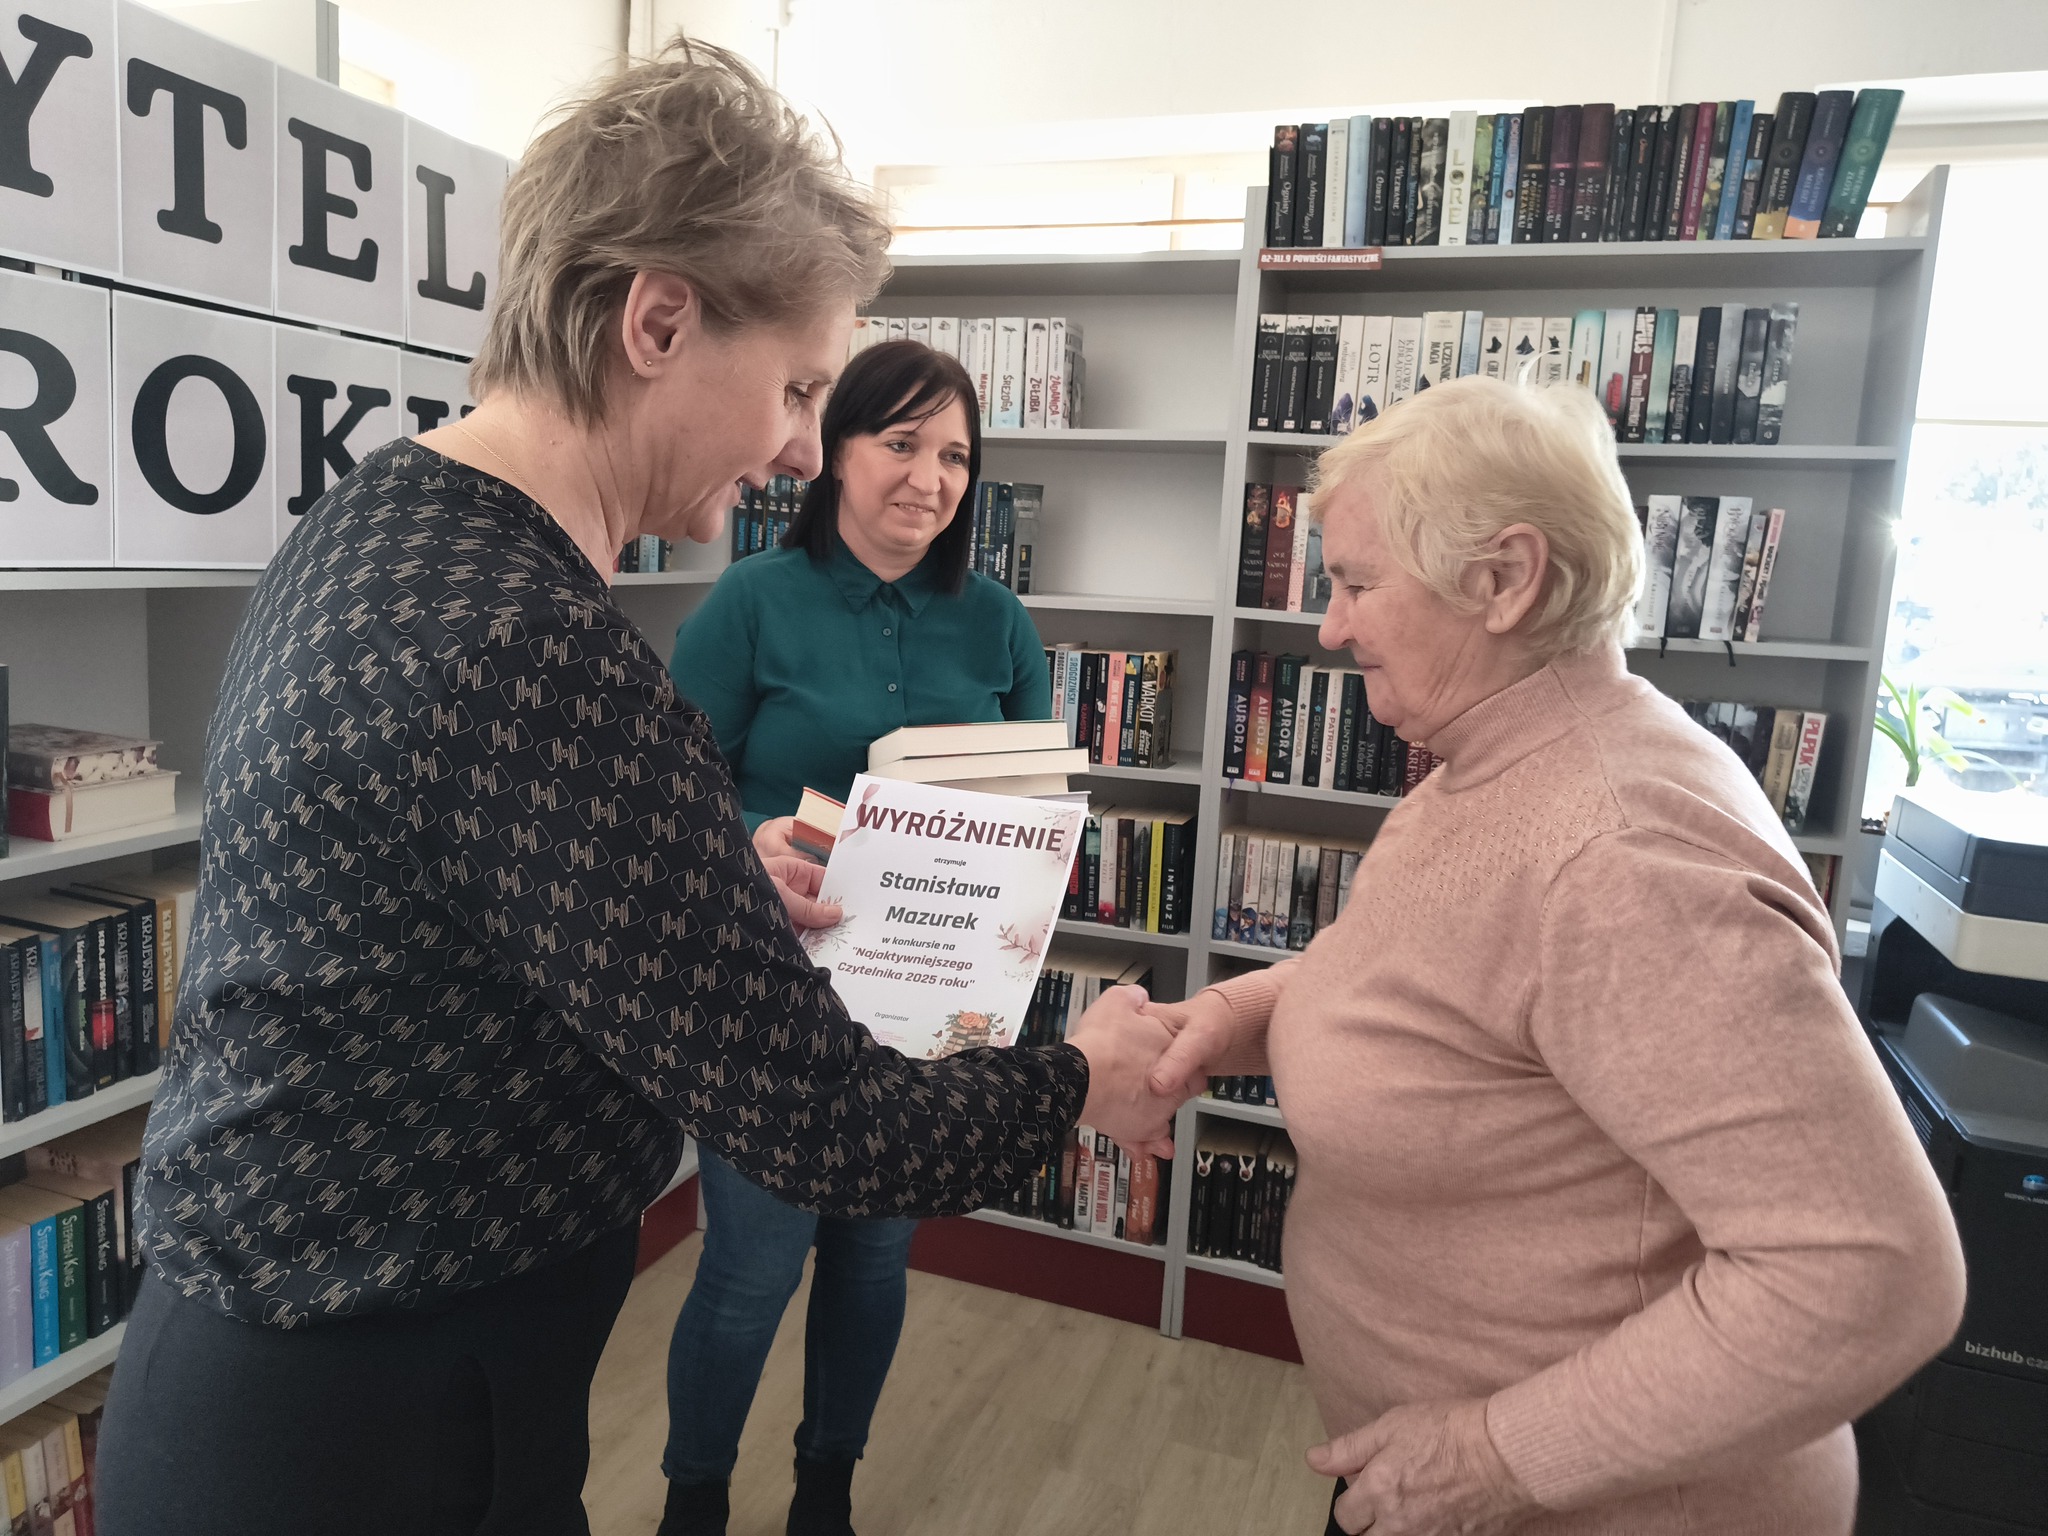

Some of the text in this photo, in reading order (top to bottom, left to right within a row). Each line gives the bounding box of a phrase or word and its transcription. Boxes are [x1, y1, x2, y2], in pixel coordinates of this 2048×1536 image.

[1429, 341, 1441, 365] MAGA
[1633, 313, 1656, 354] IMPULS
[1366, 343, 1382, 385] ŁOTR
[1401, 339, 1416, 392] KRÓLOWA
[1029, 377, 1042, 413] ZGŁOBA
[0, 327, 476, 516] ROK
[1000, 543, 1008, 570] Kocham
[1056, 656, 1066, 690] ROGOZIŃSKI
[1067, 662, 1080, 705] ROGOZIŃSKI
[1139, 680, 1158, 725] WARKOT
[1232, 694, 1247, 754] AURORA
[1255, 696, 1270, 756] AURORA
[1278, 698, 1294, 759] AURORA
[1310, 714, 1321, 756] GENIUSZ
[1325, 716, 1336, 764] PATRIOTA
[1339, 717, 1352, 775] BUNTOWNIK
[1355, 740, 1367, 781] KRÓLÓW
[1364, 743, 1377, 778] STARCIE
[1406, 748, 1420, 786] KREW
[859, 804, 1065, 852] WYRÓŻNIENIE
[934, 856, 967, 868] otrzymuje
[879, 870, 1001, 900] Stanisława
[1164, 868, 1176, 921] INTRUZ
[884, 905, 979, 930] Mazurek
[115, 922, 130, 996] KRAJEWSKI
[141, 914, 153, 993] KRAJEWSKI
[161, 909, 174, 993] KRAJEWSKI
[852, 946, 973, 972] "Najaktywniejszego
[892, 936, 941, 950] konkursie
[943, 942, 956, 951] na
[75, 940, 87, 993] Krajewski
[98, 930, 112, 1000] KRAJEWSKI
[837, 961, 976, 989] Czytelnika 2025 roku"
[9, 953, 22, 1023] KRAJEWSKI
[874, 1011, 910, 1022] Organizator
[1077, 1183, 1089, 1217] MARTWA
[1096, 1170, 1110, 1201] MARTWA
[62, 1215, 79, 1288] STEPHEN KING
[97, 1199, 110, 1271] STEPHEN KING
[36, 1225, 53, 1300] STEPHEN KING
[1965, 1340, 2024, 1364] bizhub
